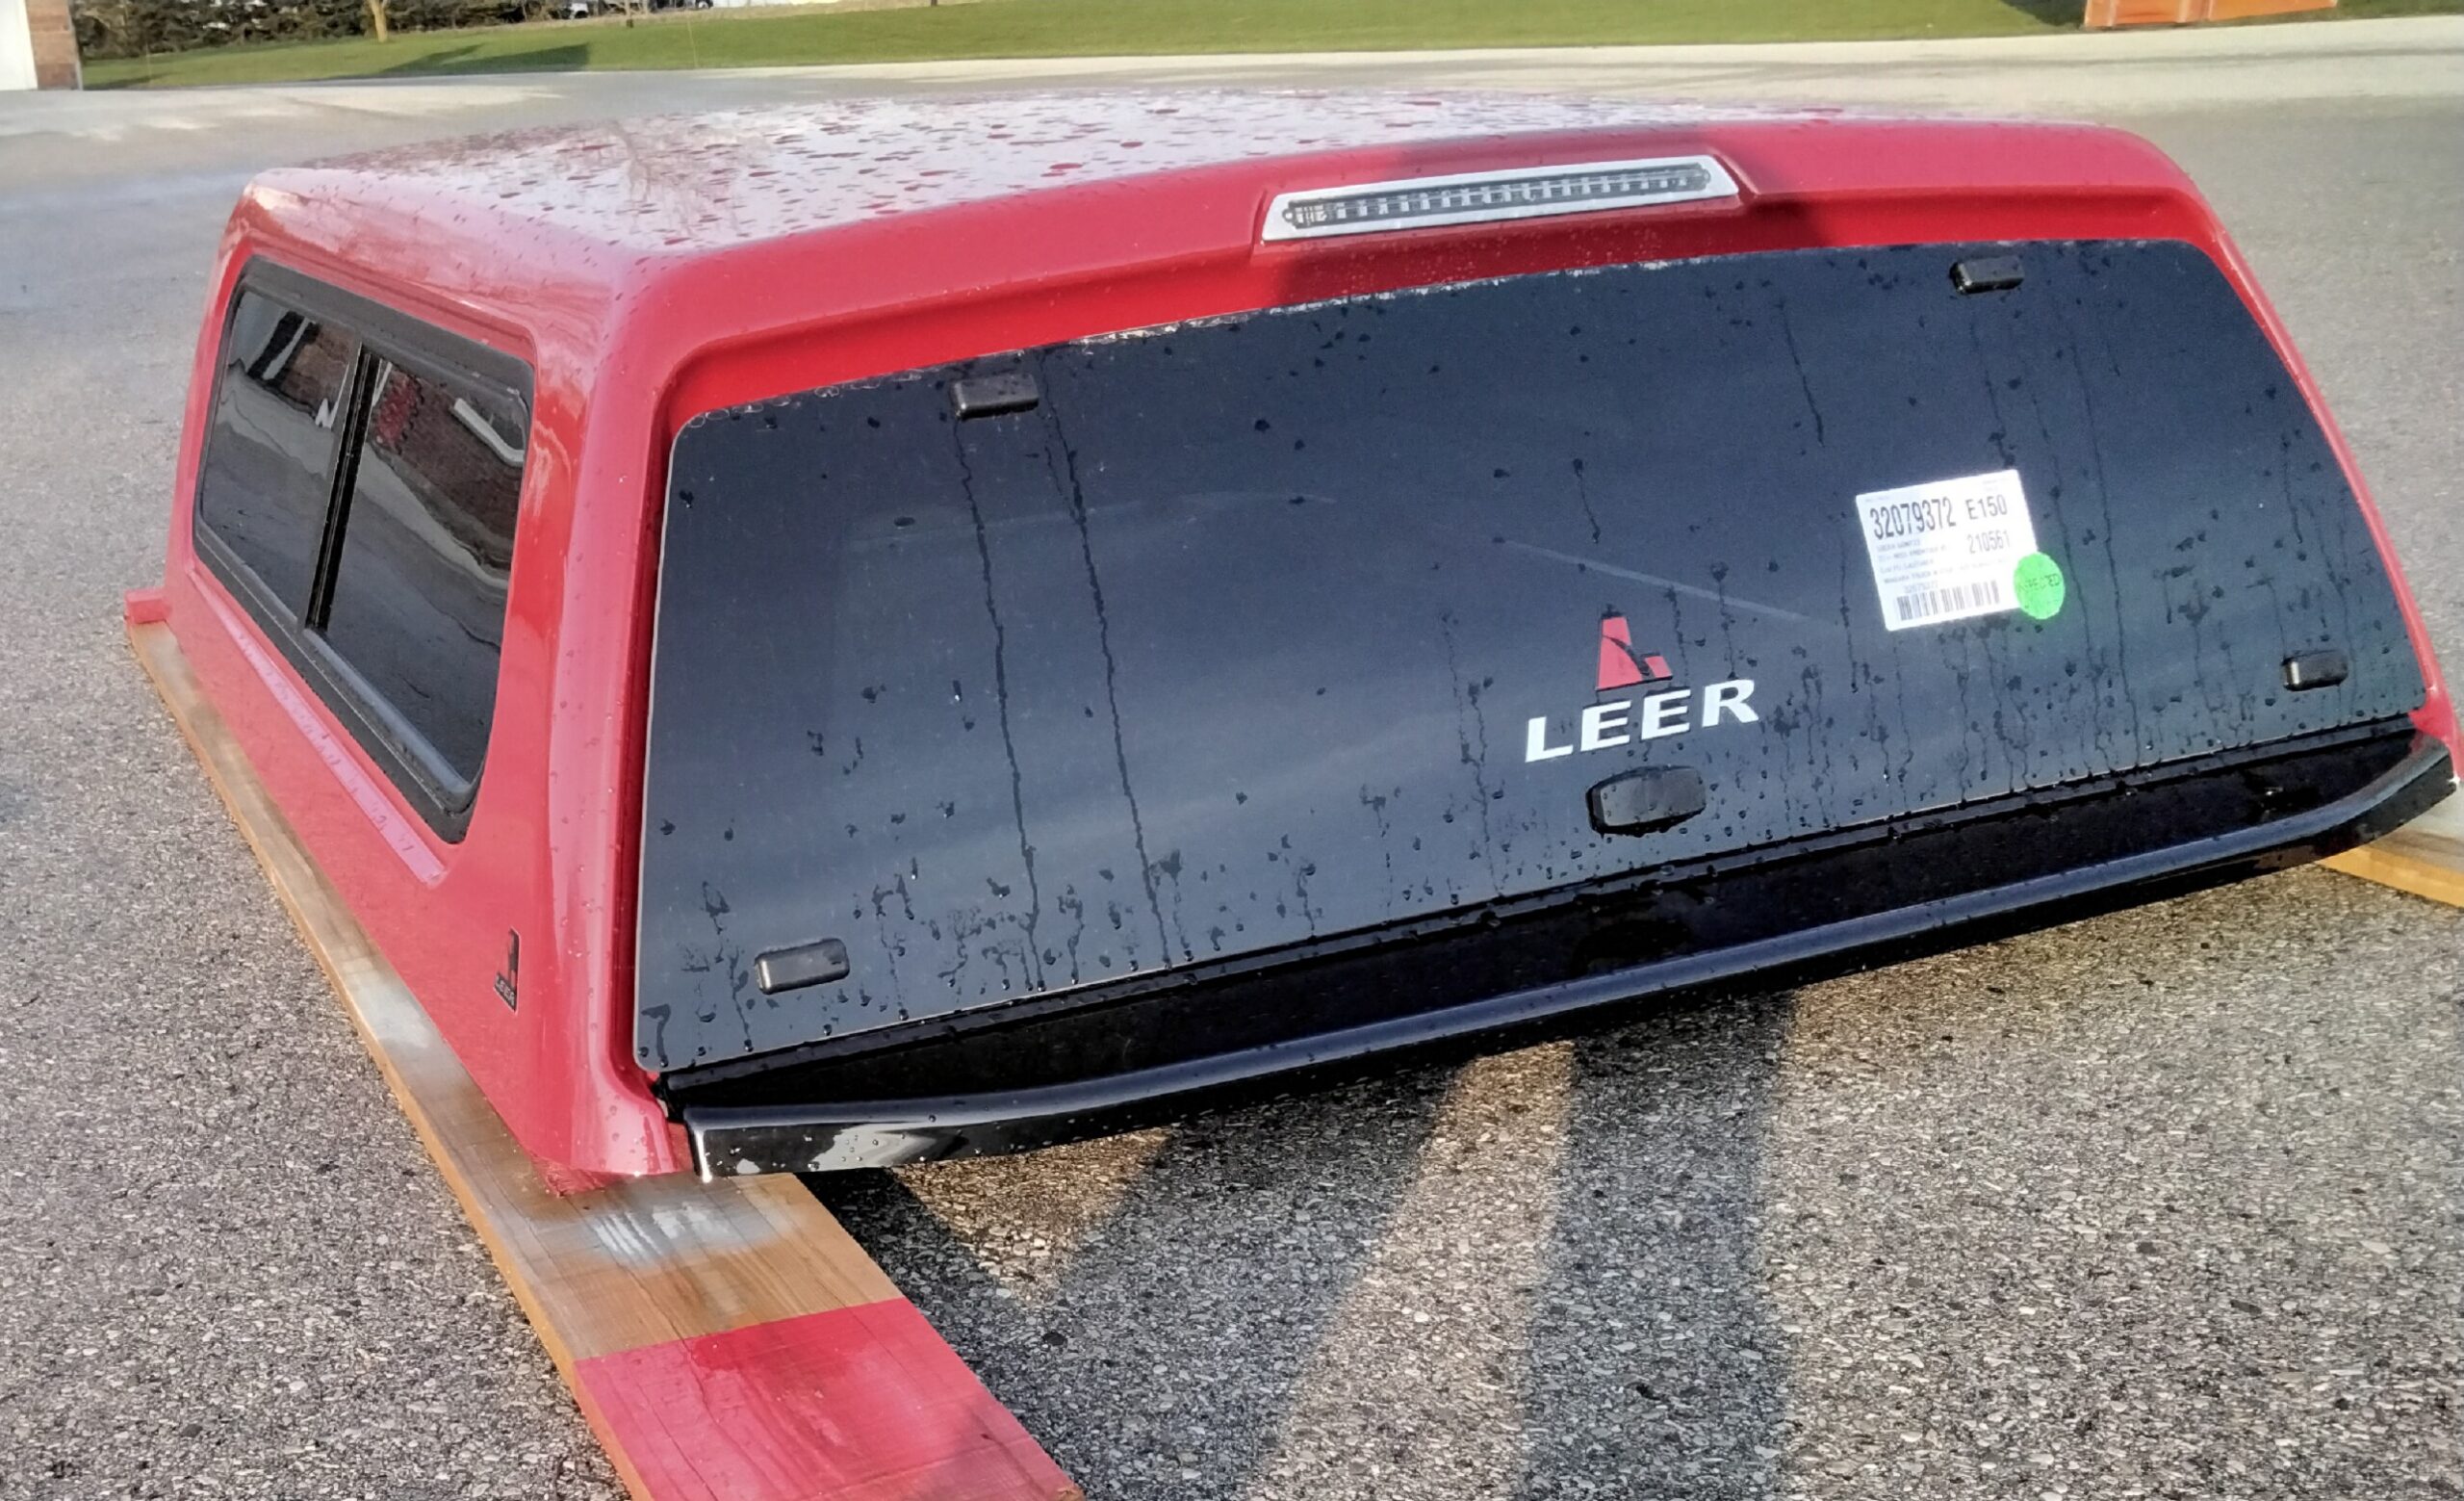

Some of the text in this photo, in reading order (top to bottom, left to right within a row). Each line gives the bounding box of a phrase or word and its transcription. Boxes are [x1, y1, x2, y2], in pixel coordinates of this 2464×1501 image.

[1870, 494, 2008, 540] 32079372 E150
[1525, 679, 1759, 763] LEER
